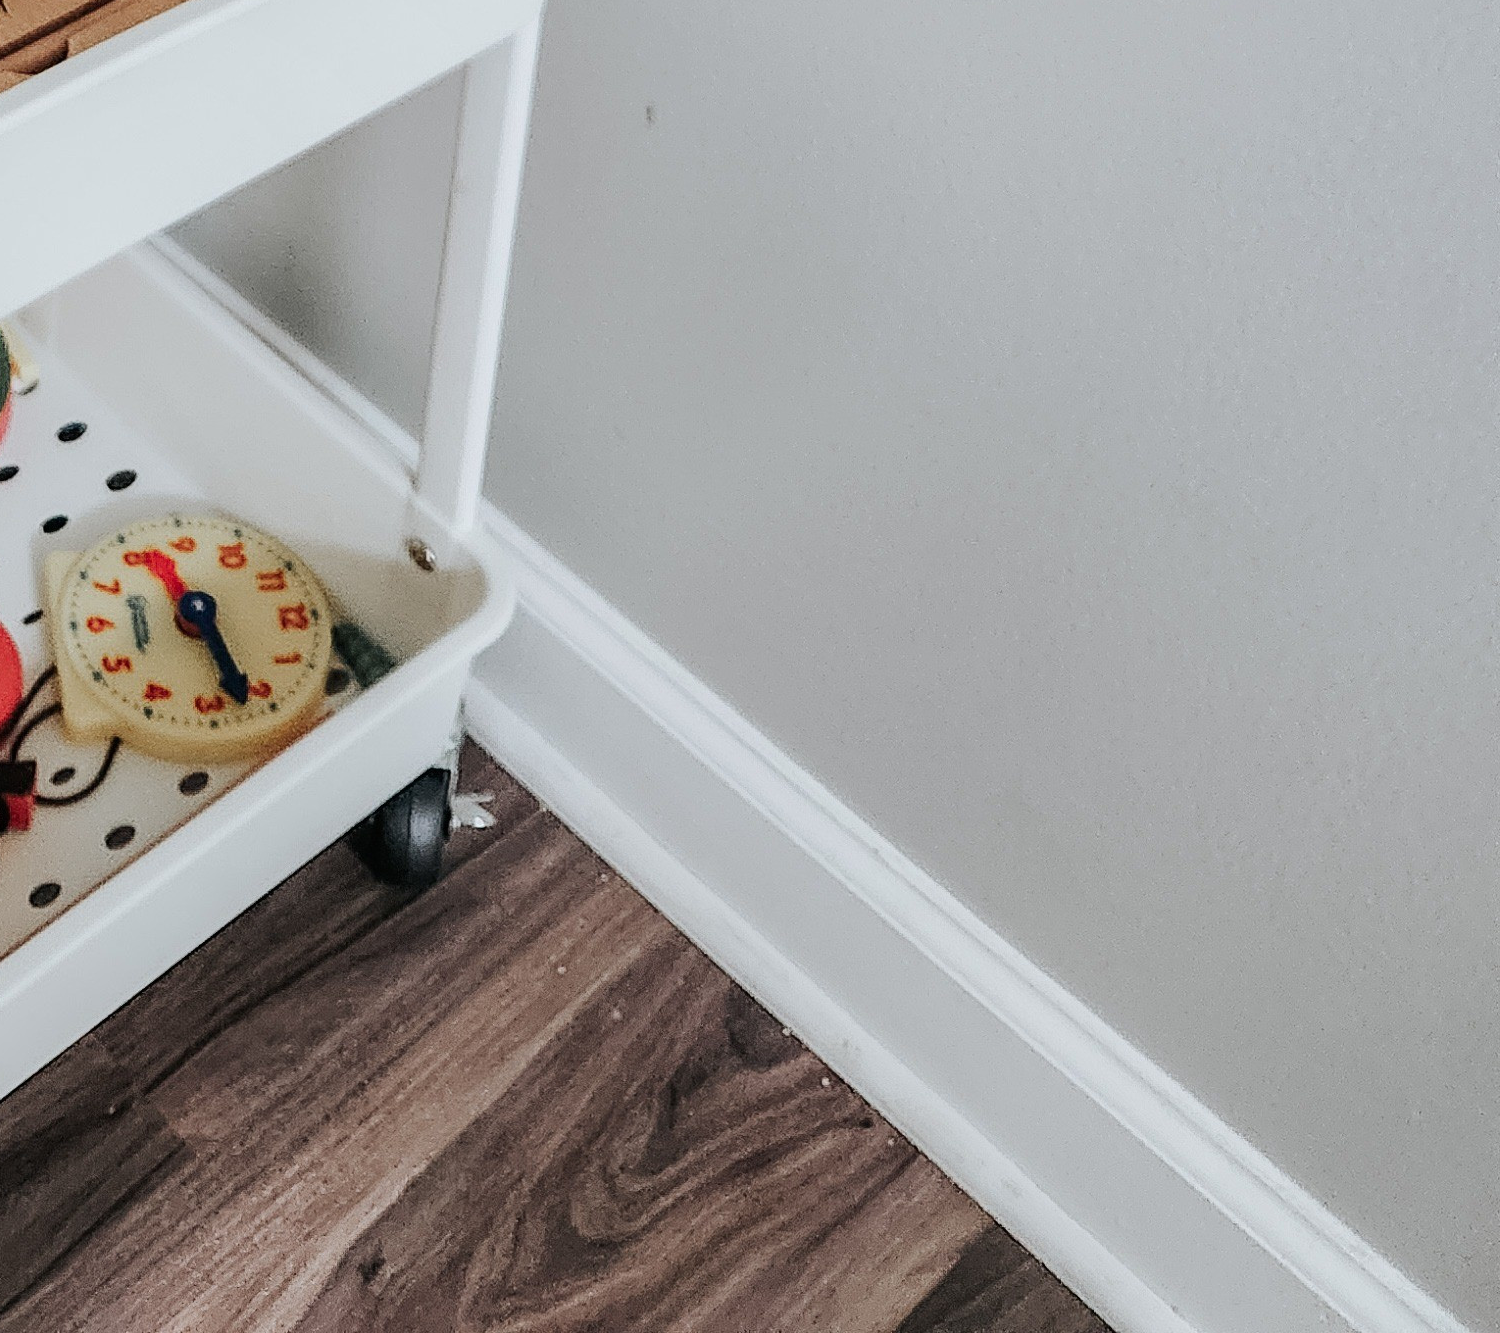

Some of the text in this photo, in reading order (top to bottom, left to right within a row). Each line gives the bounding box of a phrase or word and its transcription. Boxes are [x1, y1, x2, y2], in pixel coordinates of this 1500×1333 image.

[169, 536, 197, 553] 9
[218, 541, 247, 570] 10
[92, 579, 122, 594] 7
[256, 568, 287, 592] 11
[86, 614, 115, 634] 6
[277, 603, 310, 631] 12
[101, 654, 133, 673] 5
[273, 652, 303, 665] 1
[144, 682, 172, 702] 4
[249, 678, 273, 699] 2
[194, 694, 226, 715] 3
